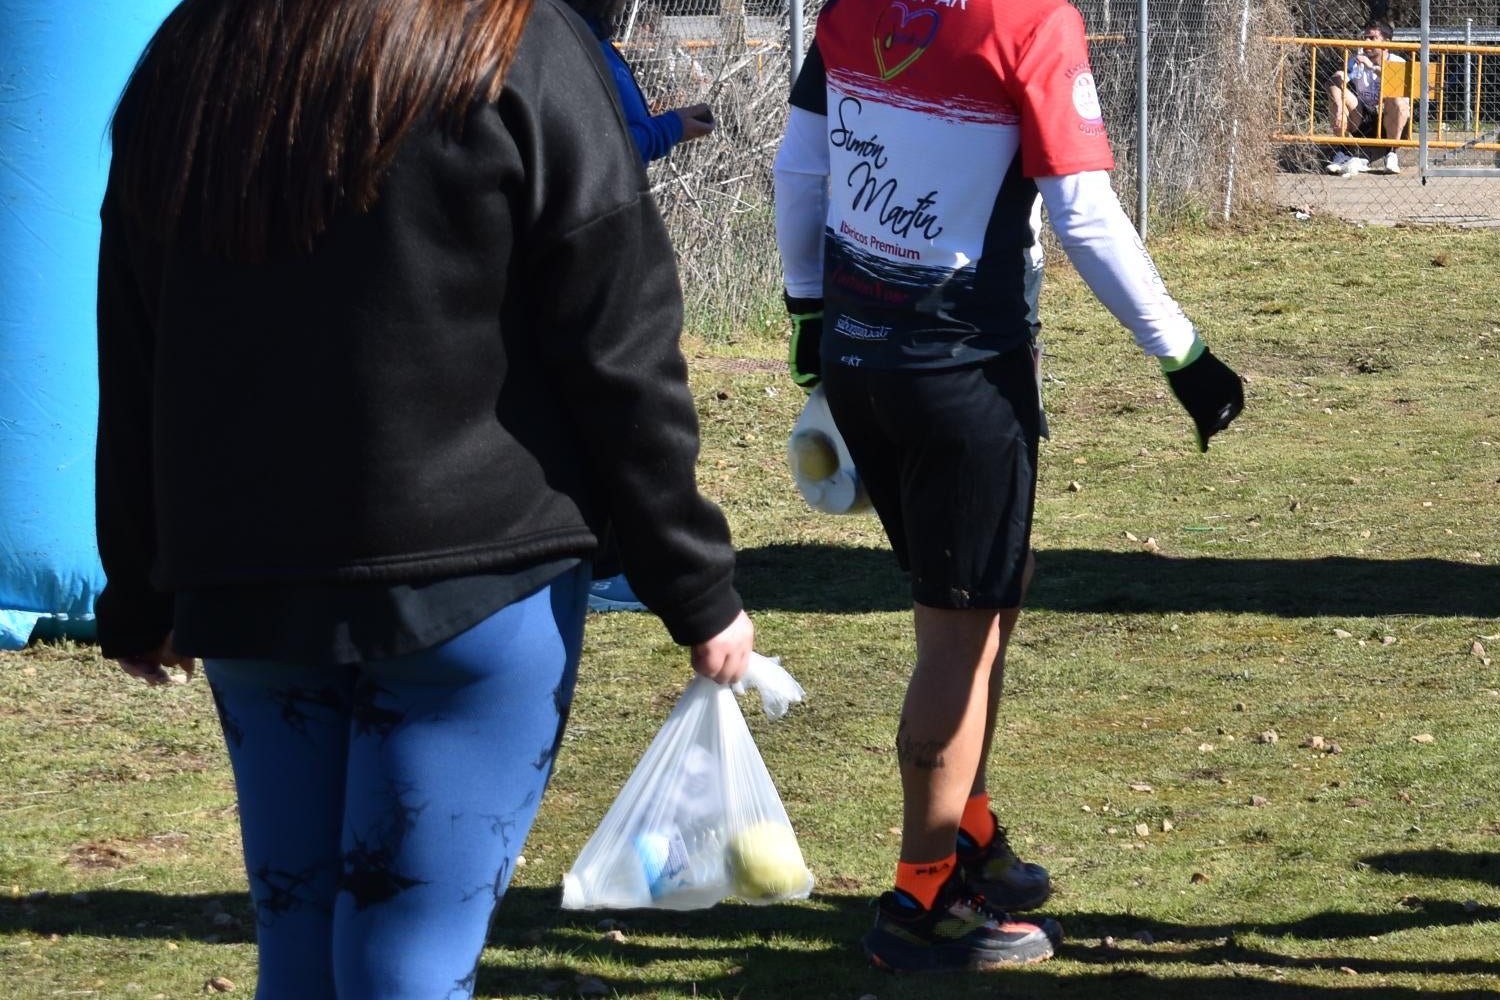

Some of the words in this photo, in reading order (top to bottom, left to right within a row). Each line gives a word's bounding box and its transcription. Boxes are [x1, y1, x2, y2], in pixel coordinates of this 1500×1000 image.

[830, 96, 888, 169] Simón
[848, 161, 944, 240] Martín
[878, 239, 939, 270] Premium
